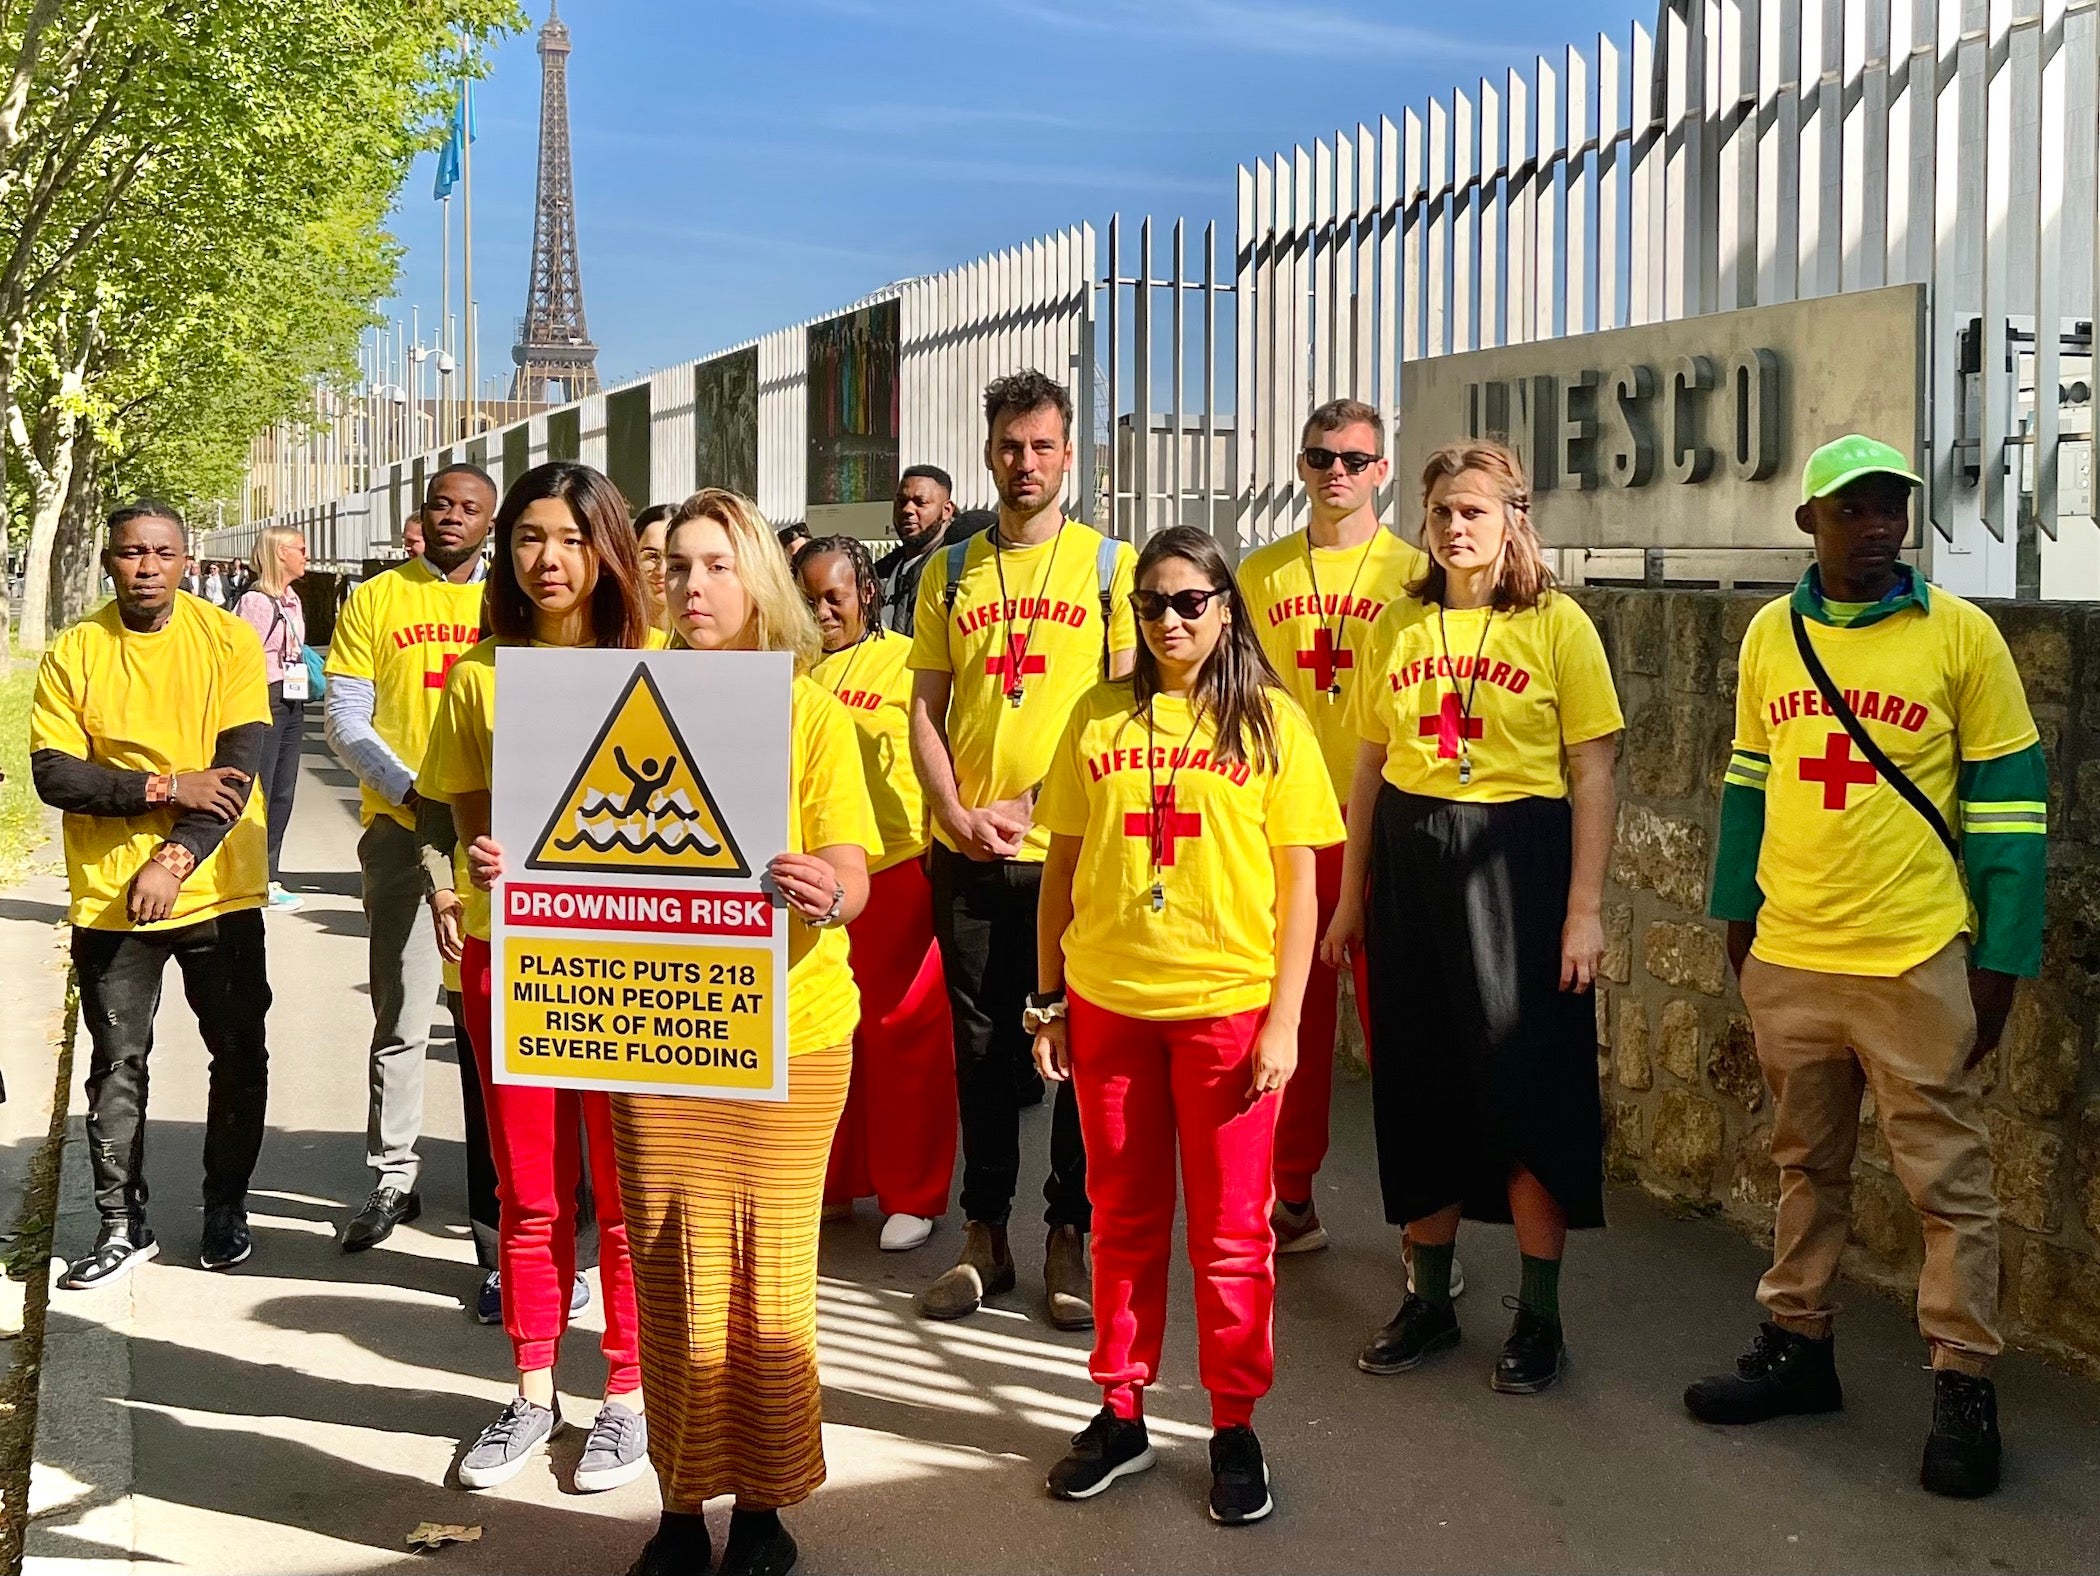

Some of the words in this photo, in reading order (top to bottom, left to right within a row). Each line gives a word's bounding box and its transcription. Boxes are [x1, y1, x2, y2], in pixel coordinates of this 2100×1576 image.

[956, 597, 1087, 637] LIFEGUARD
[1388, 655, 1531, 694] LIFEGUARD
[510, 890, 682, 925] DROWNING
[690, 897, 767, 927] RISK
[520, 955, 626, 980] PLASTIC
[633, 960, 701, 984] PUTS
[709, 964, 755, 986] 218
[513, 982, 614, 1006] MILLION
[622, 988, 723, 1012] PEOPLE
[730, 993, 763, 1014] AT
[545, 1011, 605, 1034] RISK
[612, 1014, 647, 1035] OF
[653, 1017, 729, 1040] MORE
[518, 1036, 618, 1061] SEVERE
[626, 1043, 758, 1069] FLOODING
